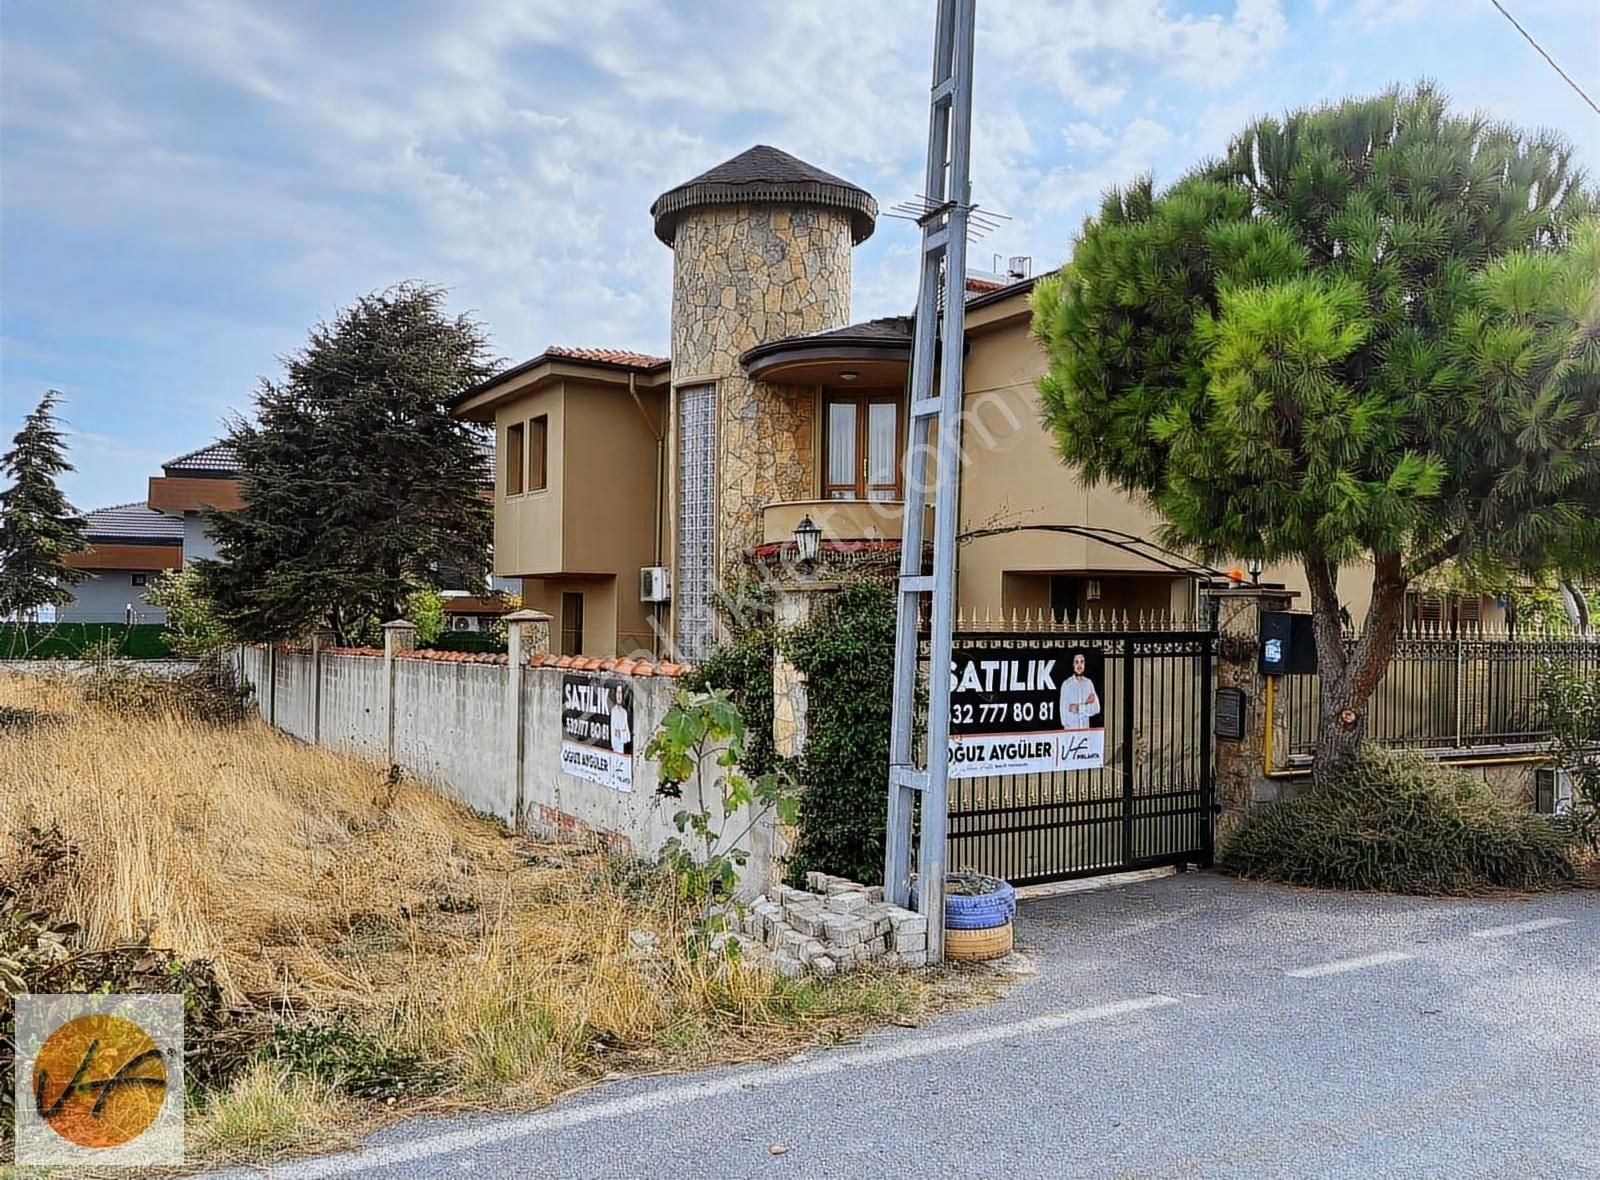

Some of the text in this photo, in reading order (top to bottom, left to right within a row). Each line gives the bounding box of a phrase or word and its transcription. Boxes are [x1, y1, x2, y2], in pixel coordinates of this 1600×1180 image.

[565, 683, 610, 716] SATILIK
[950, 701, 1054, 724] 32 777 80 81
[989, 740, 1052, 761] AYGÜLER
